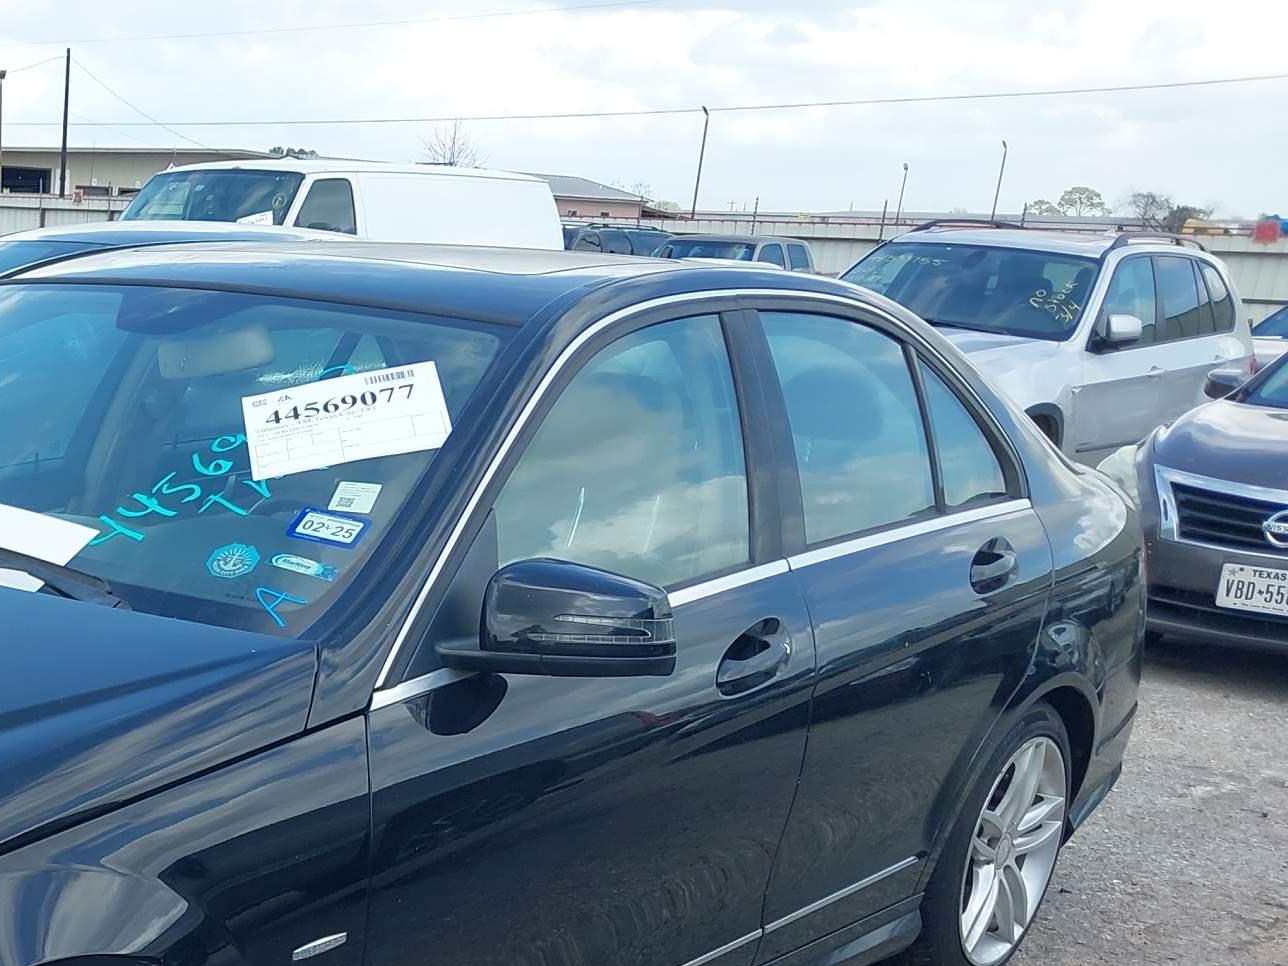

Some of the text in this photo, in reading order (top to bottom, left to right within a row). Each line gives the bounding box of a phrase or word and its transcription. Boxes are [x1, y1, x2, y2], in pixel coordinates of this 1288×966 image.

[265, 383, 415, 425] 44569077
[1251, 568, 1288, 582] TEXAS
[256, 587, 308, 628] A
[1263, 584, 1288, 606] 55
